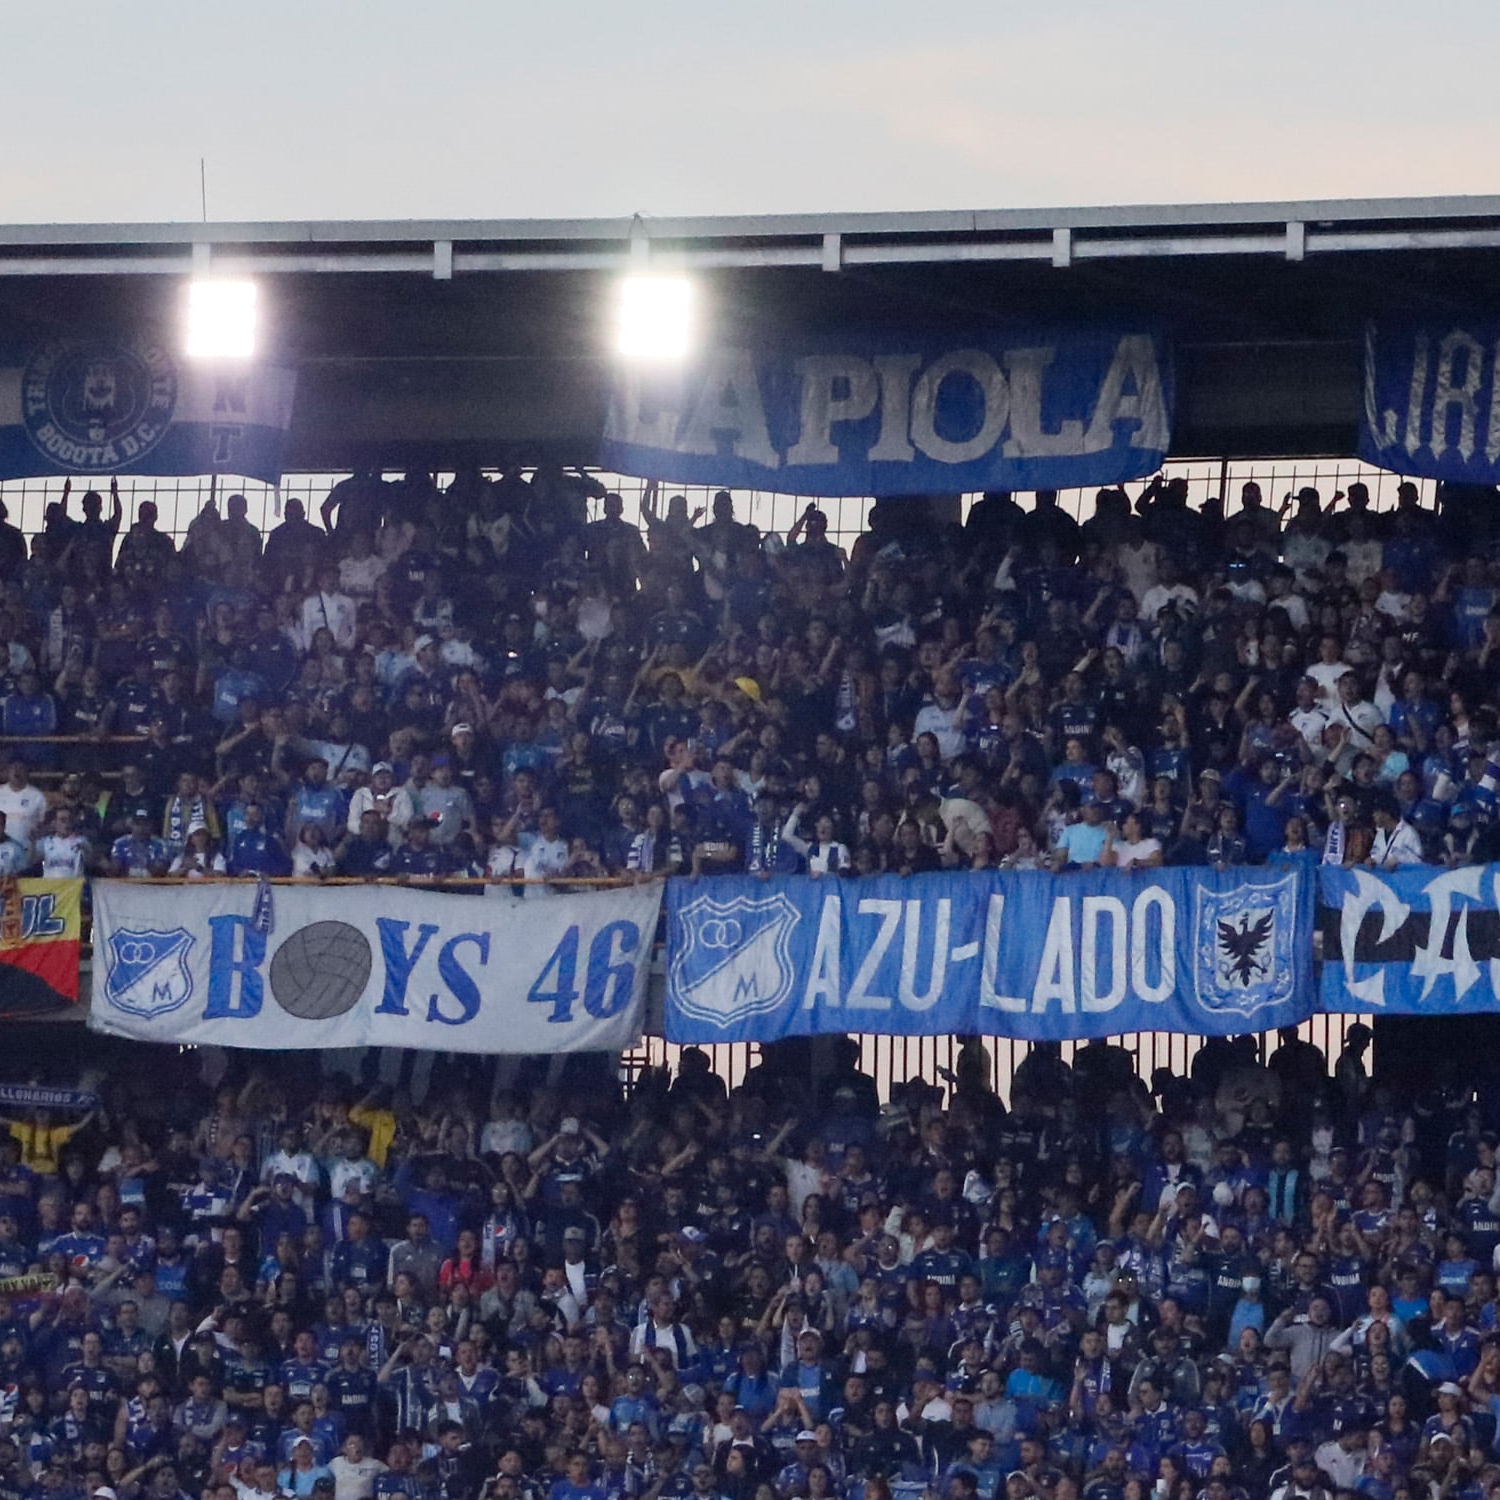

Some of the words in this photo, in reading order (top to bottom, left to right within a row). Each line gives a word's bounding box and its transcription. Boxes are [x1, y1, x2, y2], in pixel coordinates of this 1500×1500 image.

[604, 345, 780, 470] LA
[787, 334, 1171, 465] PIOLA
[210, 425, 243, 464] T
[527, 919, 641, 1023] 46
[735, 973, 759, 1000] M
[152, 981, 174, 1002] M
